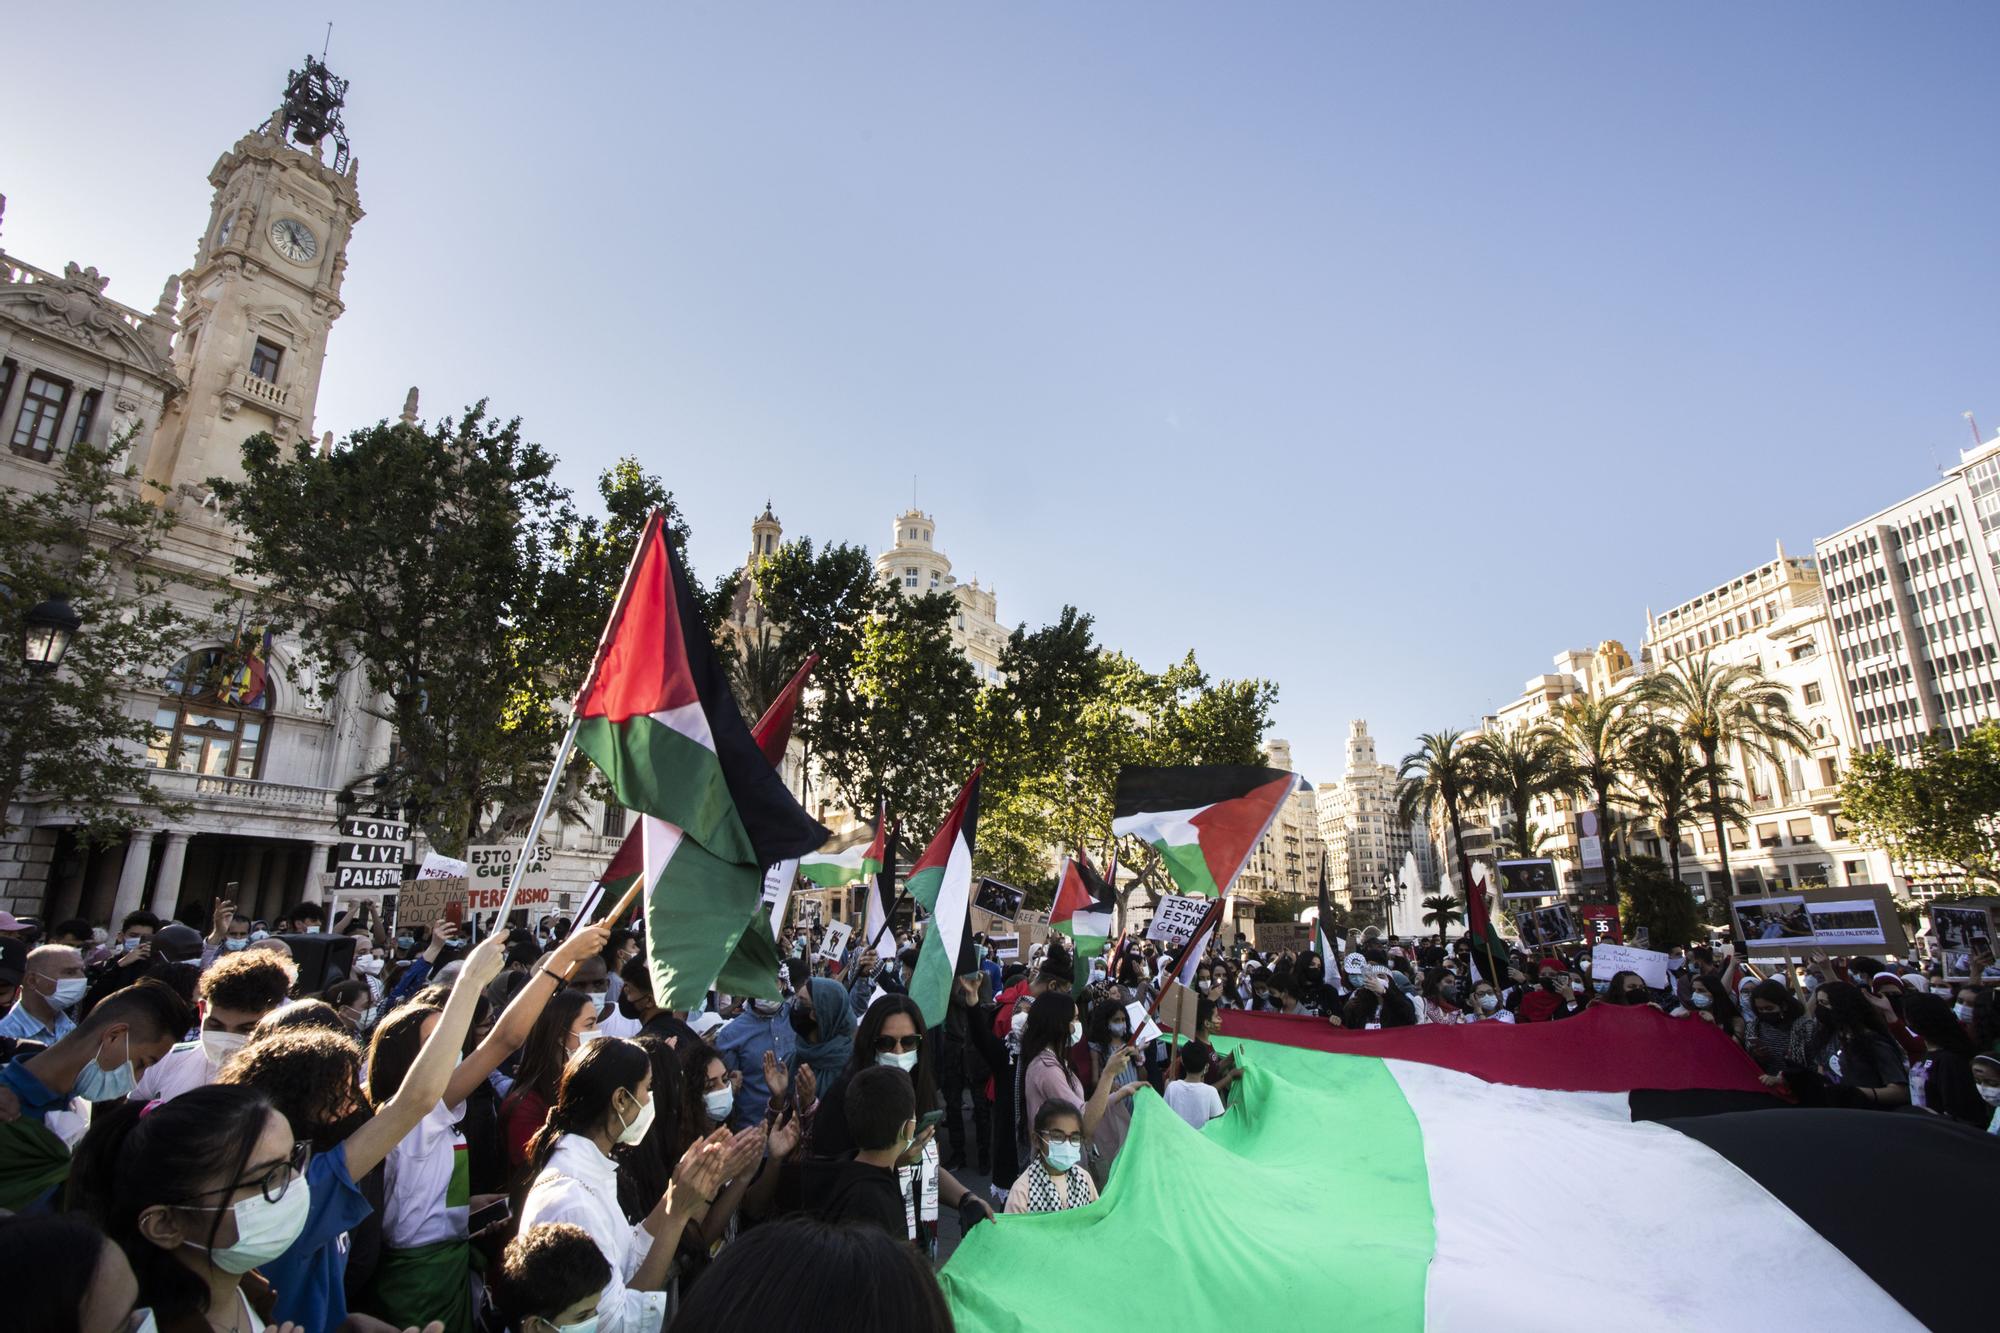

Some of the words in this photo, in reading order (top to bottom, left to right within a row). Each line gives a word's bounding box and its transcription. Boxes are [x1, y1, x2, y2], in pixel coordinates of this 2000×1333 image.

[353, 822, 404, 840] LONG
[351, 844, 401, 864] LIVE
[472, 850, 511, 864] ESTO
[340, 869, 402, 887] PALESTINE
[401, 880, 430, 892] END
[436, 878, 465, 891] THE
[468, 888, 549, 908] TERRISMO
[1019, 912, 1034, 922] REE
[1163, 910, 1201, 926] ESTAD
[1157, 922, 1192, 938] GENOC
[1595, 920, 1609, 932] 36
[1845, 928, 1880, 936] PALESTINOS
